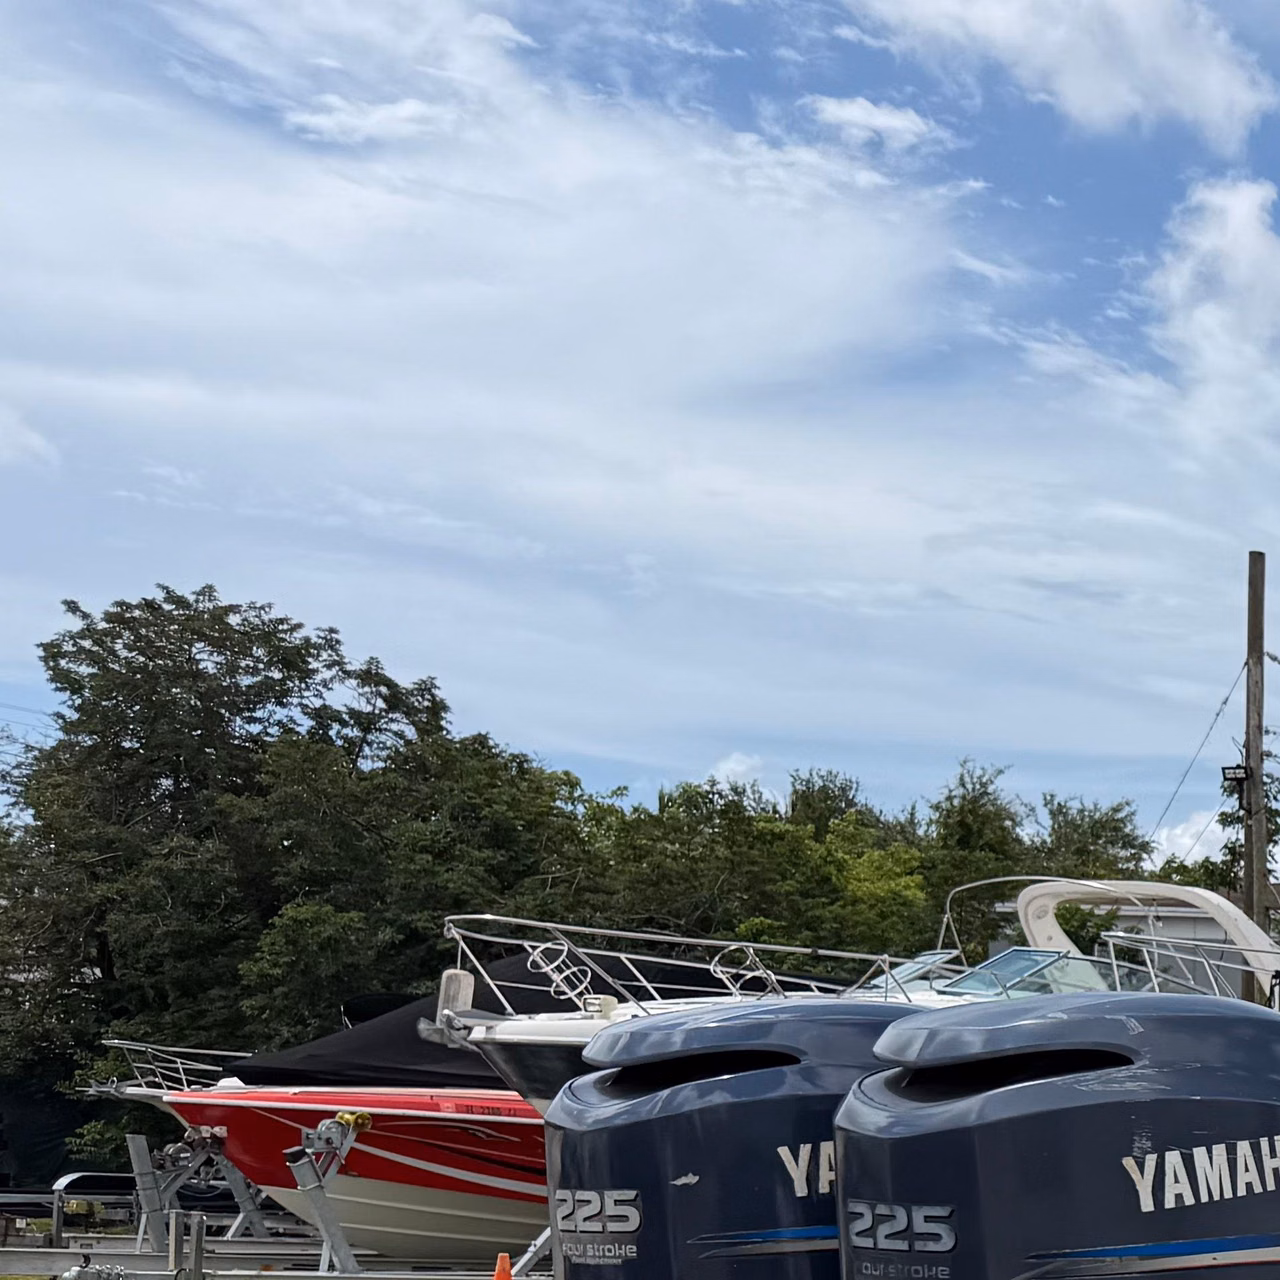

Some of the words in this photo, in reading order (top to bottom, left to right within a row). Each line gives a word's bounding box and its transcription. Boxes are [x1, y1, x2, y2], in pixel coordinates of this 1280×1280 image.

[777, 1141, 836, 1198] YA
[555, 1189, 642, 1233] 225
[847, 1202, 958, 1253] 225
